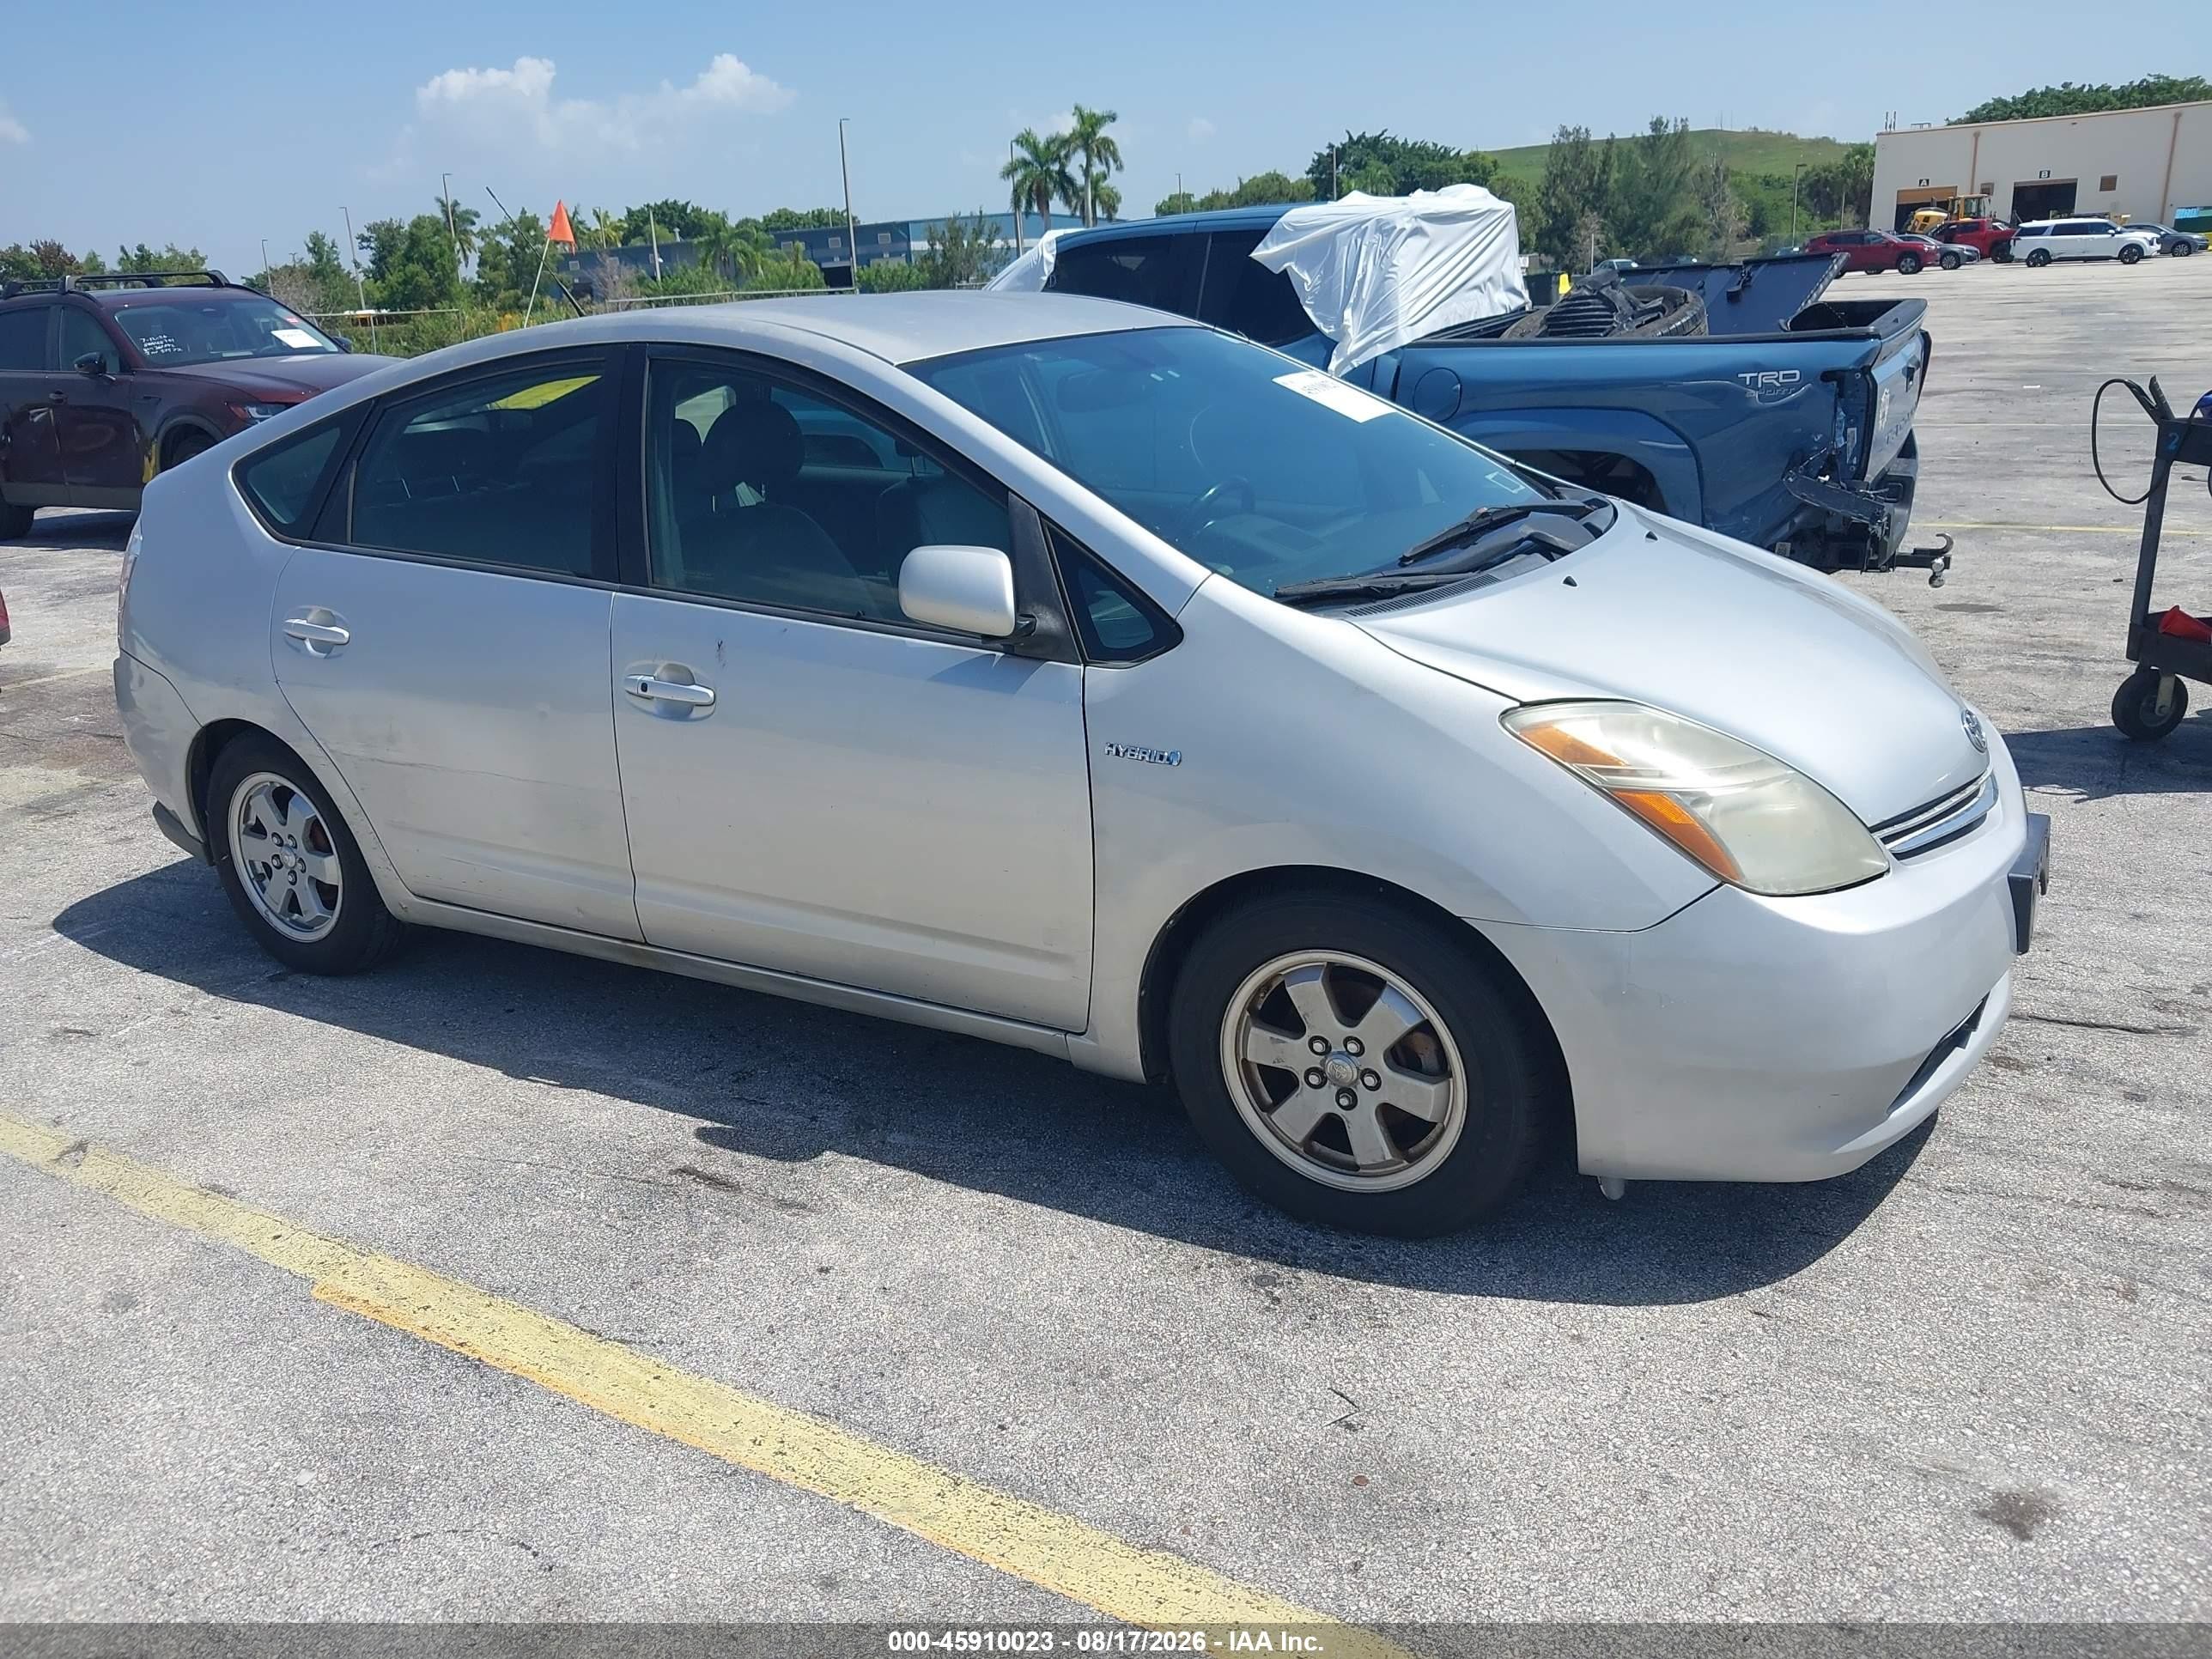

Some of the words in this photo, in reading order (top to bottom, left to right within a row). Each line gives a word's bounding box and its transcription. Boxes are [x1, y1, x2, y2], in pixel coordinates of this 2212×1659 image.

[1737, 369, 1801, 388] TRD
[2168, 432, 2179, 451] 2
[1104, 742, 1170, 765] HYBRID
